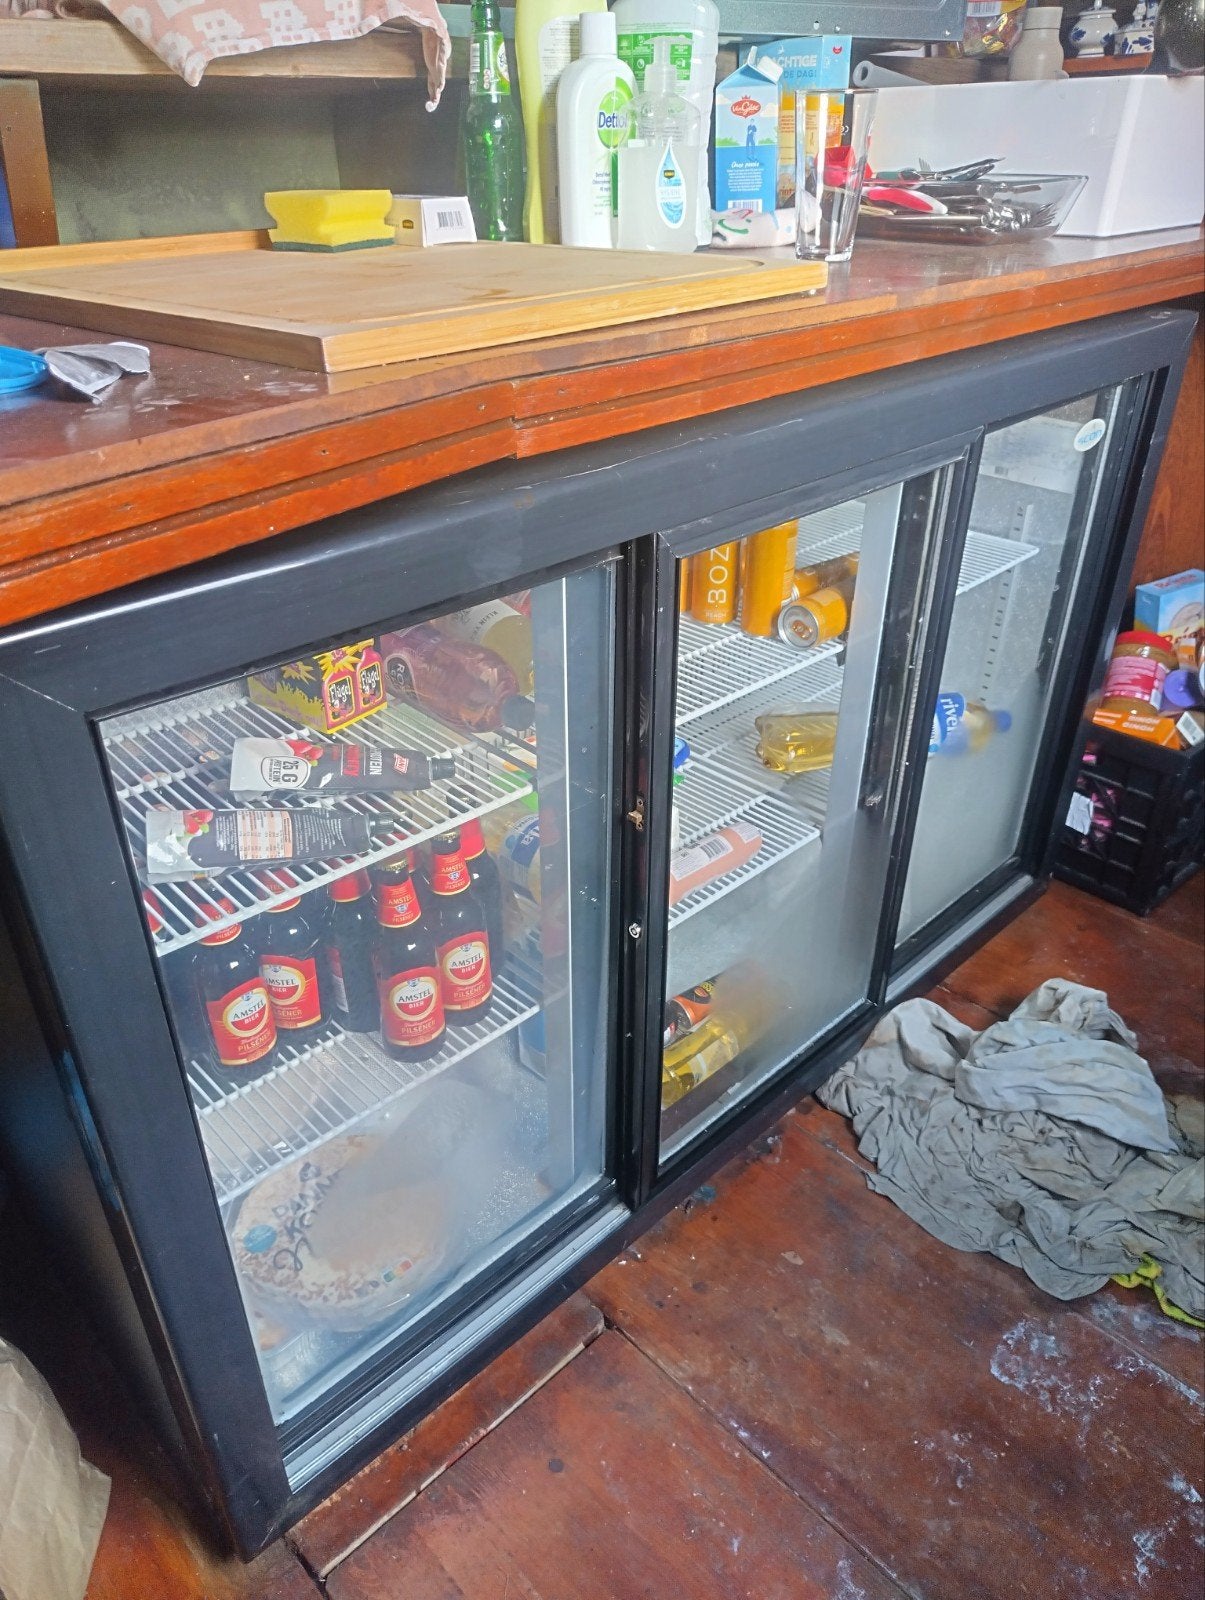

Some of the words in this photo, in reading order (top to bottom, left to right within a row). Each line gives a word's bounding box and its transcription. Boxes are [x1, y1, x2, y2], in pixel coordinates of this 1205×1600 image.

[783, 70, 794, 79] DE
[797, 69, 817, 78] DAG!
[598, 111, 628, 128] Dettol
[281, 773, 298, 783] G
[451, 953, 481, 967] AMSTEL
[461, 965, 476, 974] BIER
[398, 988, 431, 1003] AMSTEL
[453, 983, 486, 998] PILSENER
[233, 1000, 264, 1019] AMSTEL
[409, 1001, 424, 1009] BIER
[244, 1013, 259, 1024] BIER
[401, 1020, 436, 1034] PILSENER
[238, 1032, 271, 1051] PILSENER
